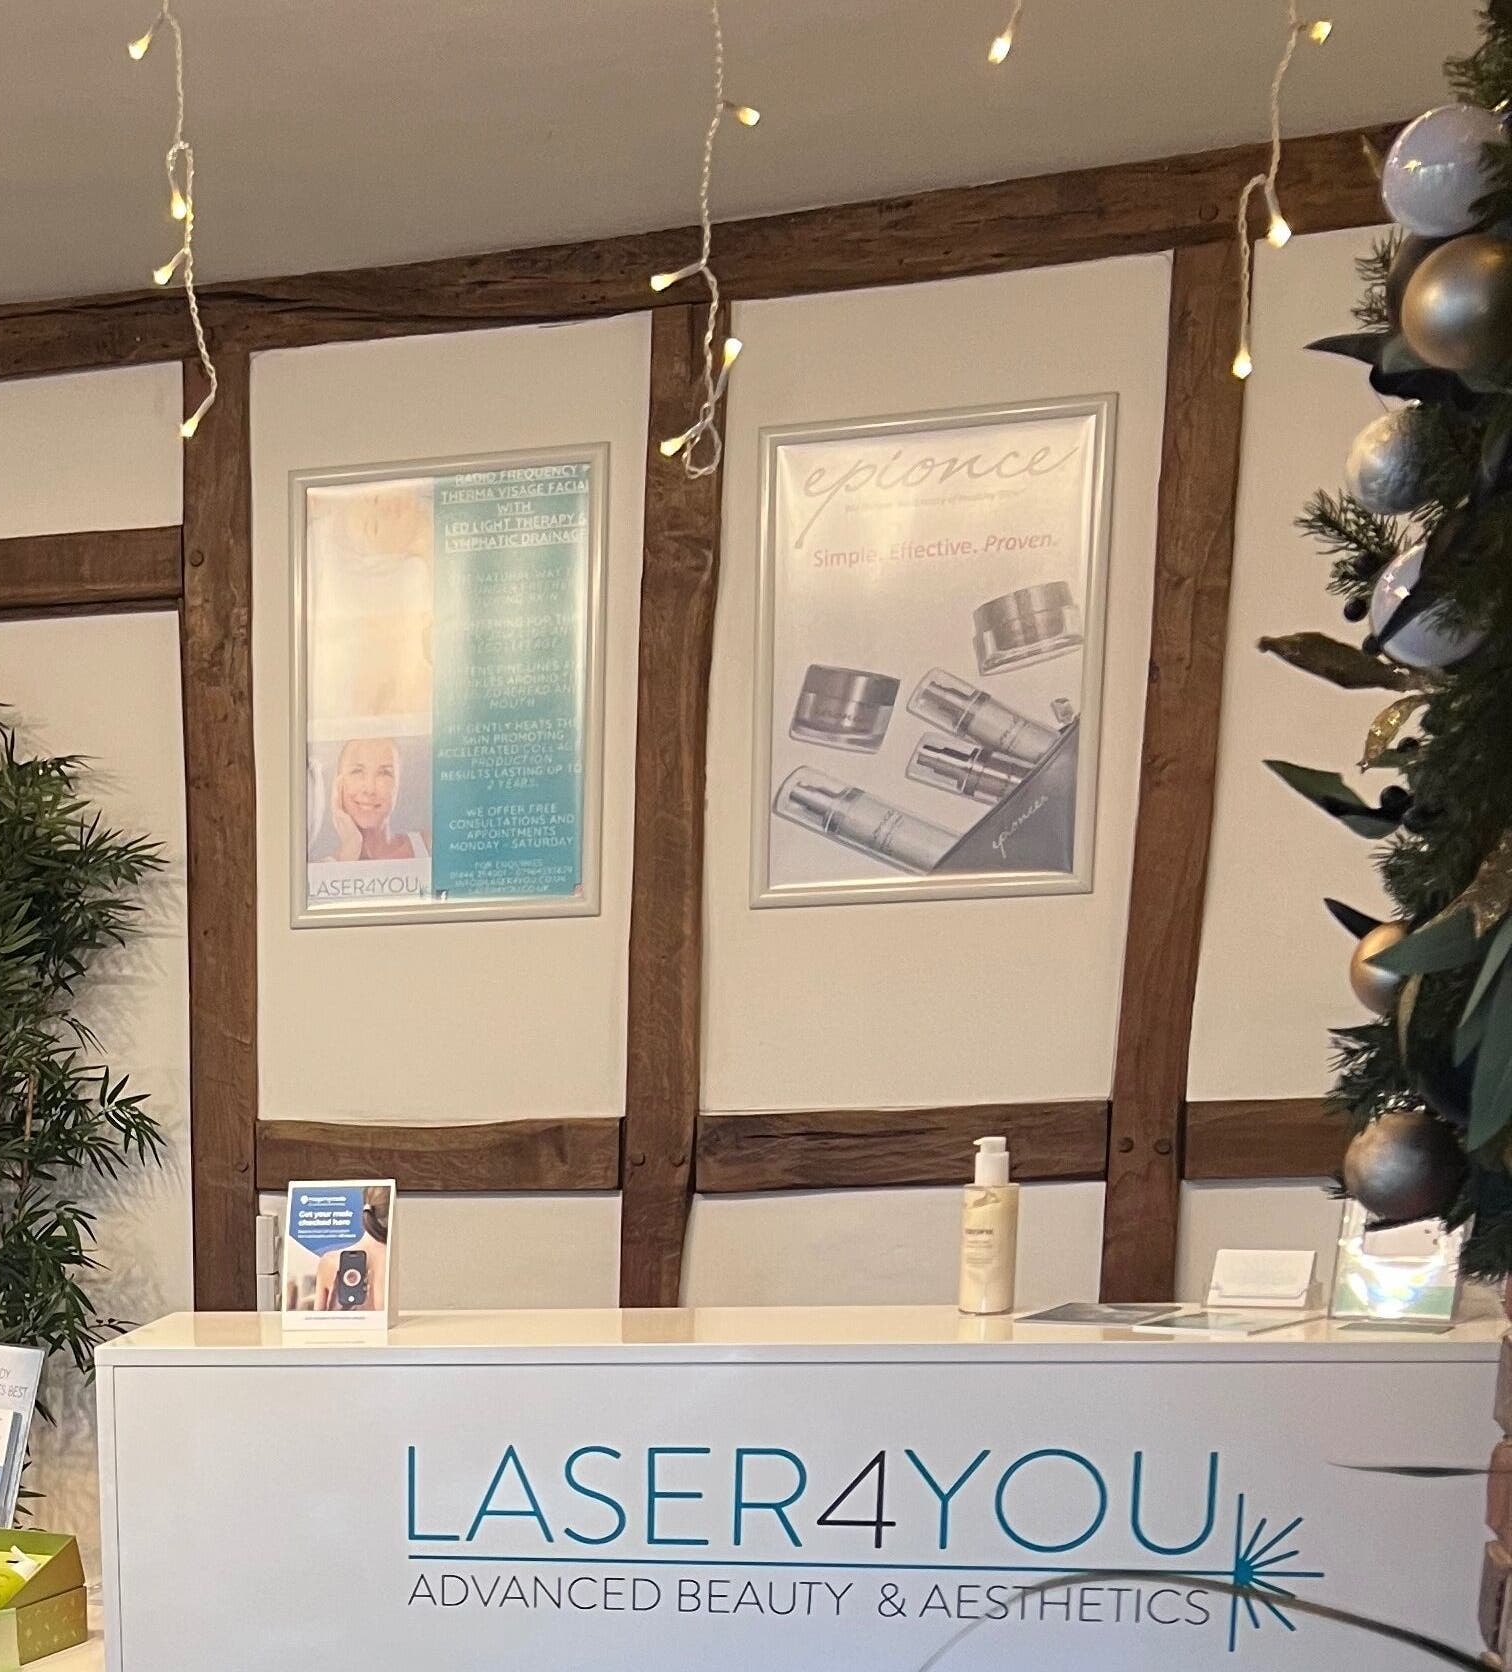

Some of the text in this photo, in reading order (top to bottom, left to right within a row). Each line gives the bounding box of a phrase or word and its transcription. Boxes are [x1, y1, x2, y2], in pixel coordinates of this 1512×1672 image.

[456, 464, 578, 486] RADIO FREQUENCY
[442, 487, 494, 503] THERMA
[498, 482, 544, 498] VISAGE
[794, 446, 1079, 549] epionce
[497, 501, 531, 514] WITH
[445, 521, 469, 536] LED
[473, 518, 509, 534] LIGHT
[516, 513, 575, 529] THERAPY
[445, 534, 518, 552] LYMPHATIC
[890, 538, 978, 561] Effective.
[984, 533, 1057, 552] Proven.
[493, 731, 565, 744] PROMOTING
[471, 755, 553, 767] PRODUCTION
[441, 770, 491, 781] RESULTS
[494, 767, 544, 779] LASTING
[467, 803, 556, 817] WE OFFER FREE
[449, 813, 575, 830] CONSULTATIONS AND
[467, 826, 557, 840] APPOINTMENTS
[450, 841, 499, 851] MONDAY
[511, 836, 574, 849] SATURDAY
[308, 877, 418, 897] LASER4YOU
[8, 1385, 28, 1398] BEST
[408, 1444, 1219, 1556] LASER4YOU
[408, 1573, 1211, 1626] ADVANCED BEAUTY & AESTHETICS
